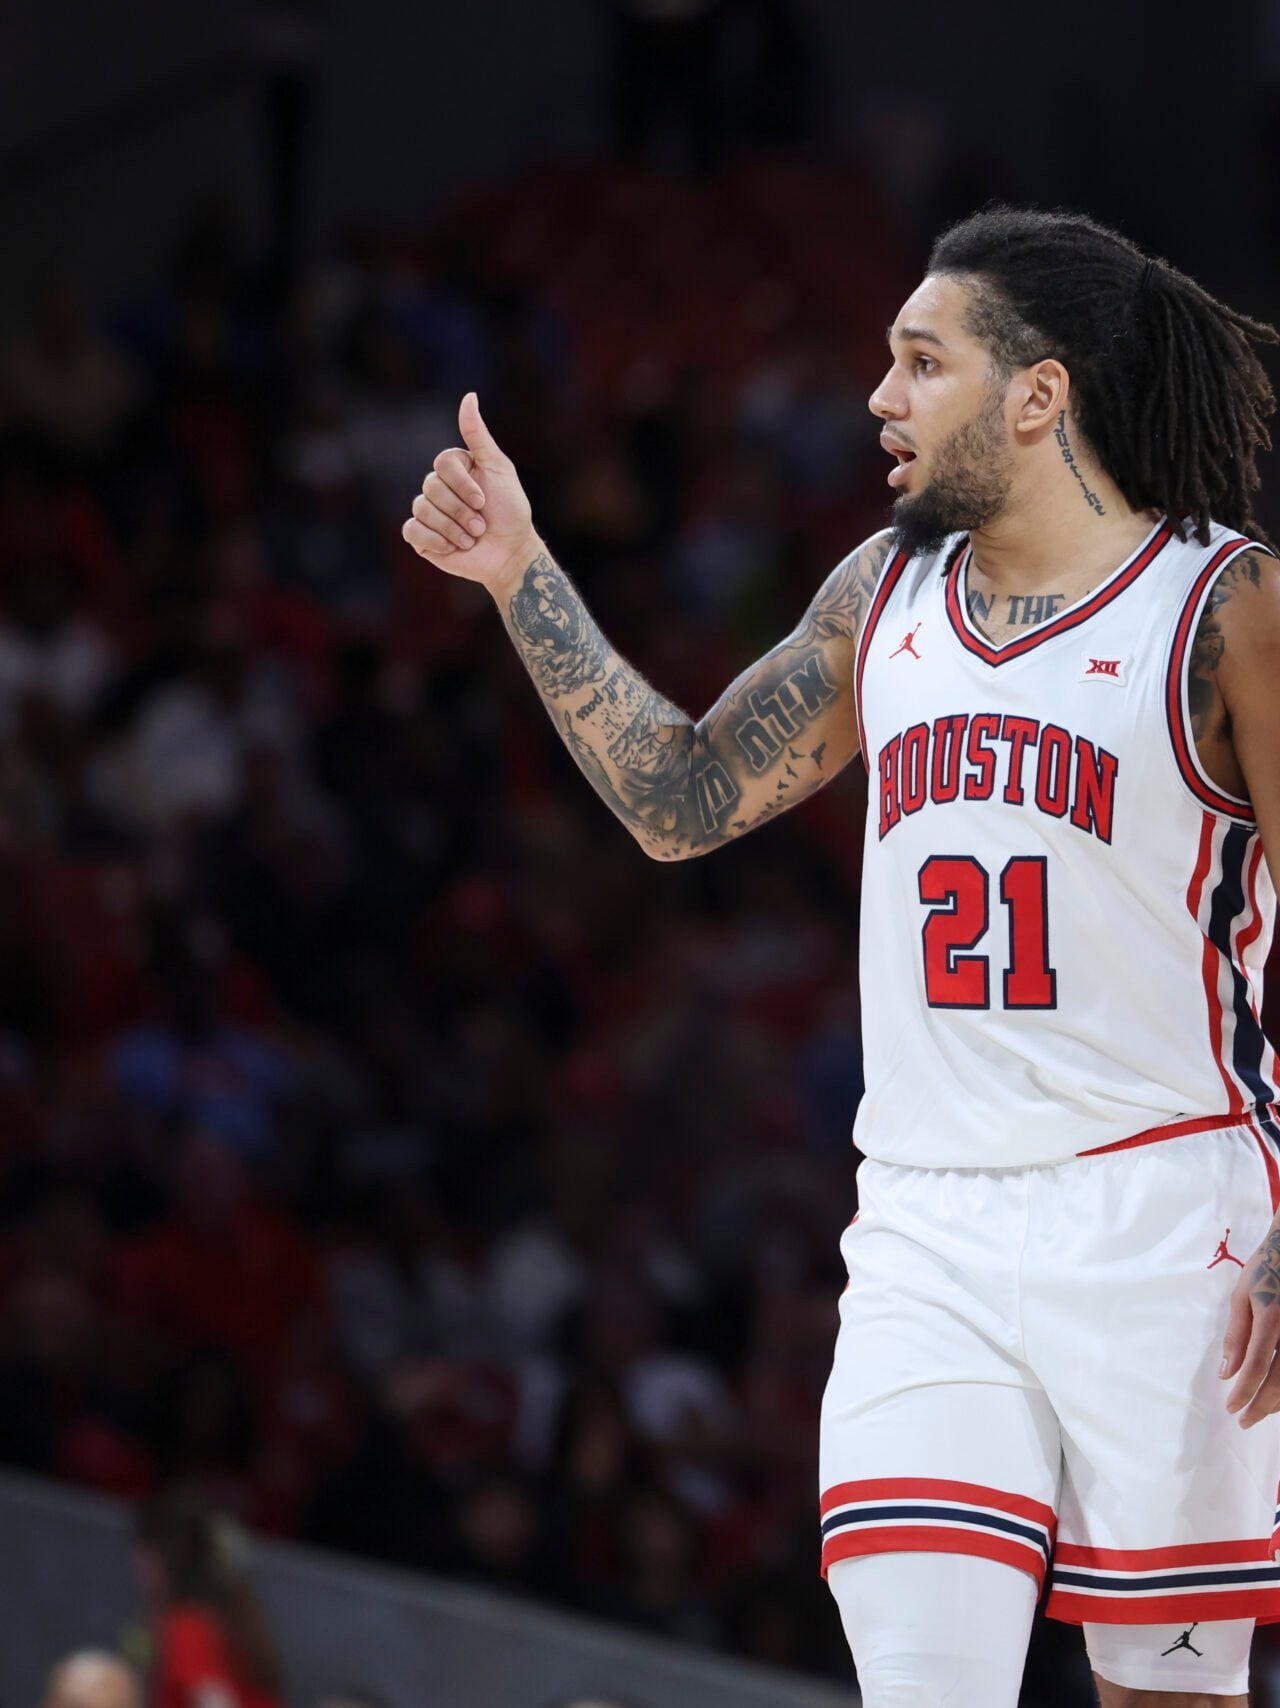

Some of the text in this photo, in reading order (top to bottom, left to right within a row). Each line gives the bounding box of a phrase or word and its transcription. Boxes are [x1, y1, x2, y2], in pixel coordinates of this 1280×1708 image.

[1006, 593, 1066, 625] THE
[1085, 658, 1121, 678] XII
[576, 687, 604, 721] pass
[879, 712, 1118, 846] HOUSTON
[918, 855, 1057, 1010] 21
